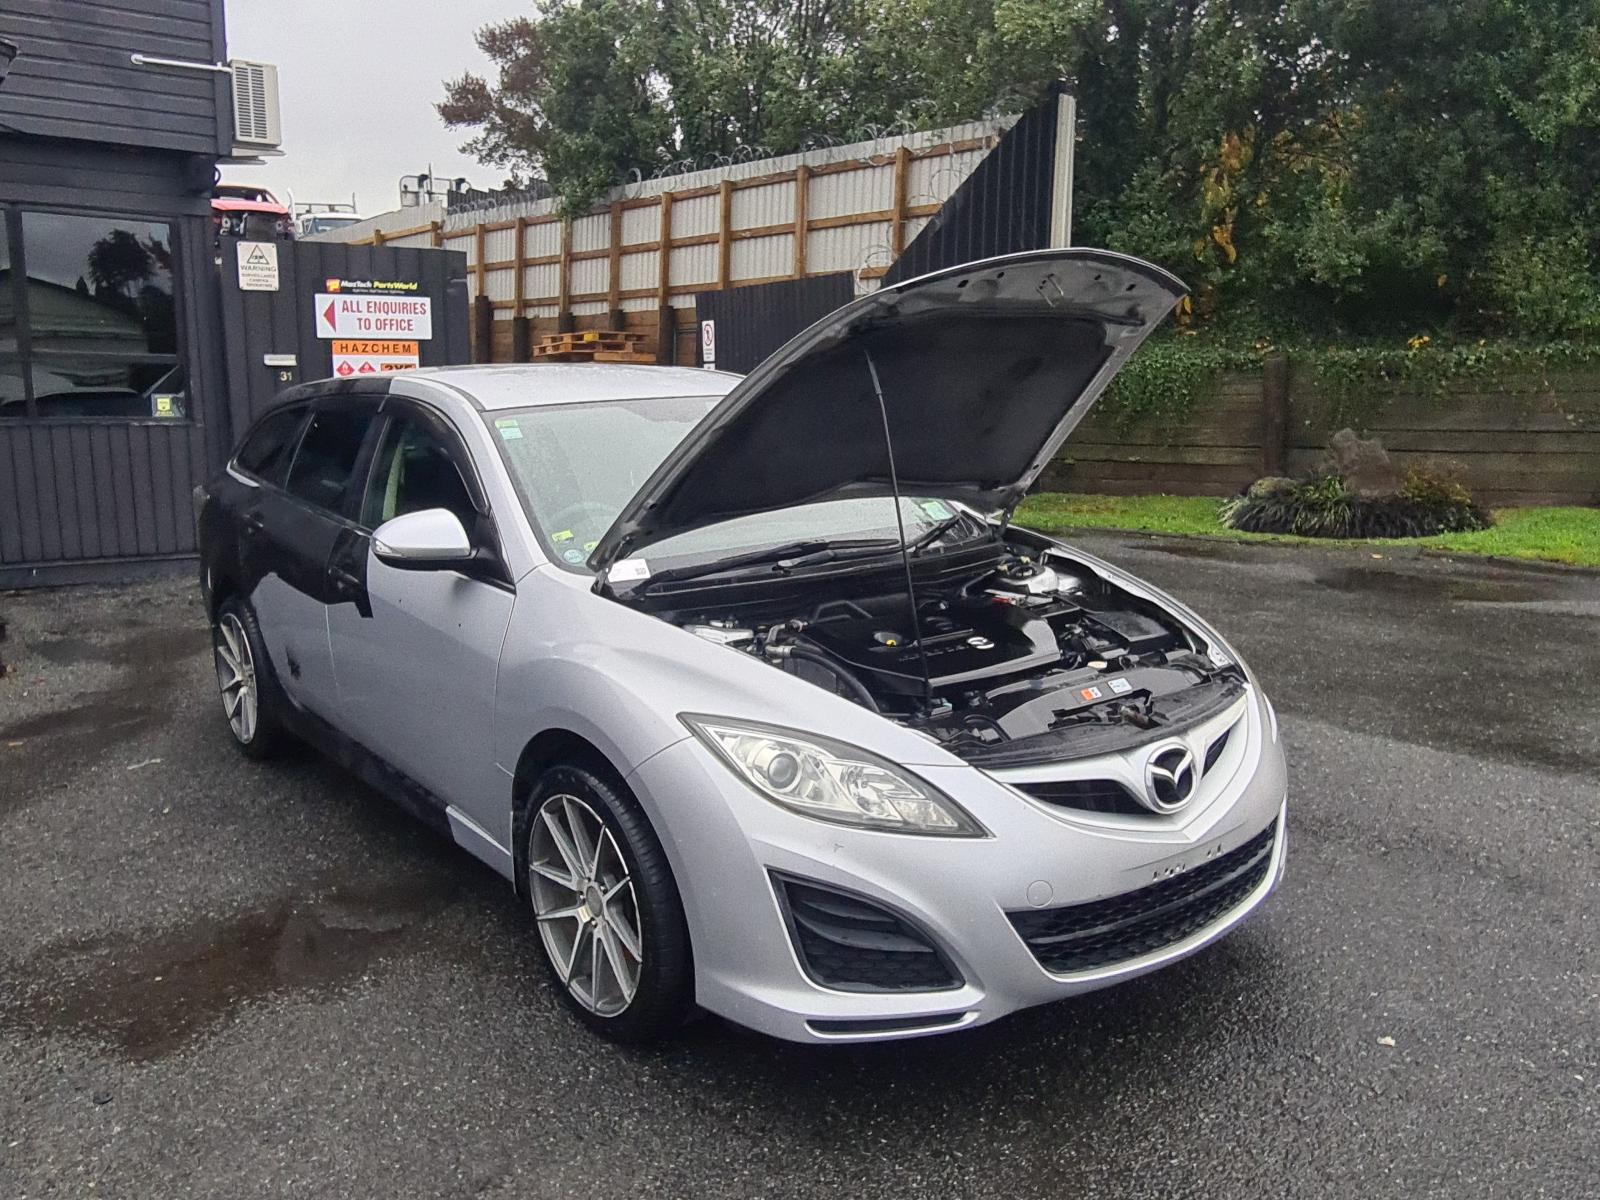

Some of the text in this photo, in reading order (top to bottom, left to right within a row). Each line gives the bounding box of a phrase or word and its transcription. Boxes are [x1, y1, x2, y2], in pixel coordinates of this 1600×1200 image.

[373, 281, 418, 290] PartsWorld
[342, 300, 427, 315] ALL ENQUIRIES
[357, 318, 414, 332] TO OFFICE
[340, 343, 411, 353] HAZCHEM
[280, 371, 292, 381] 31
